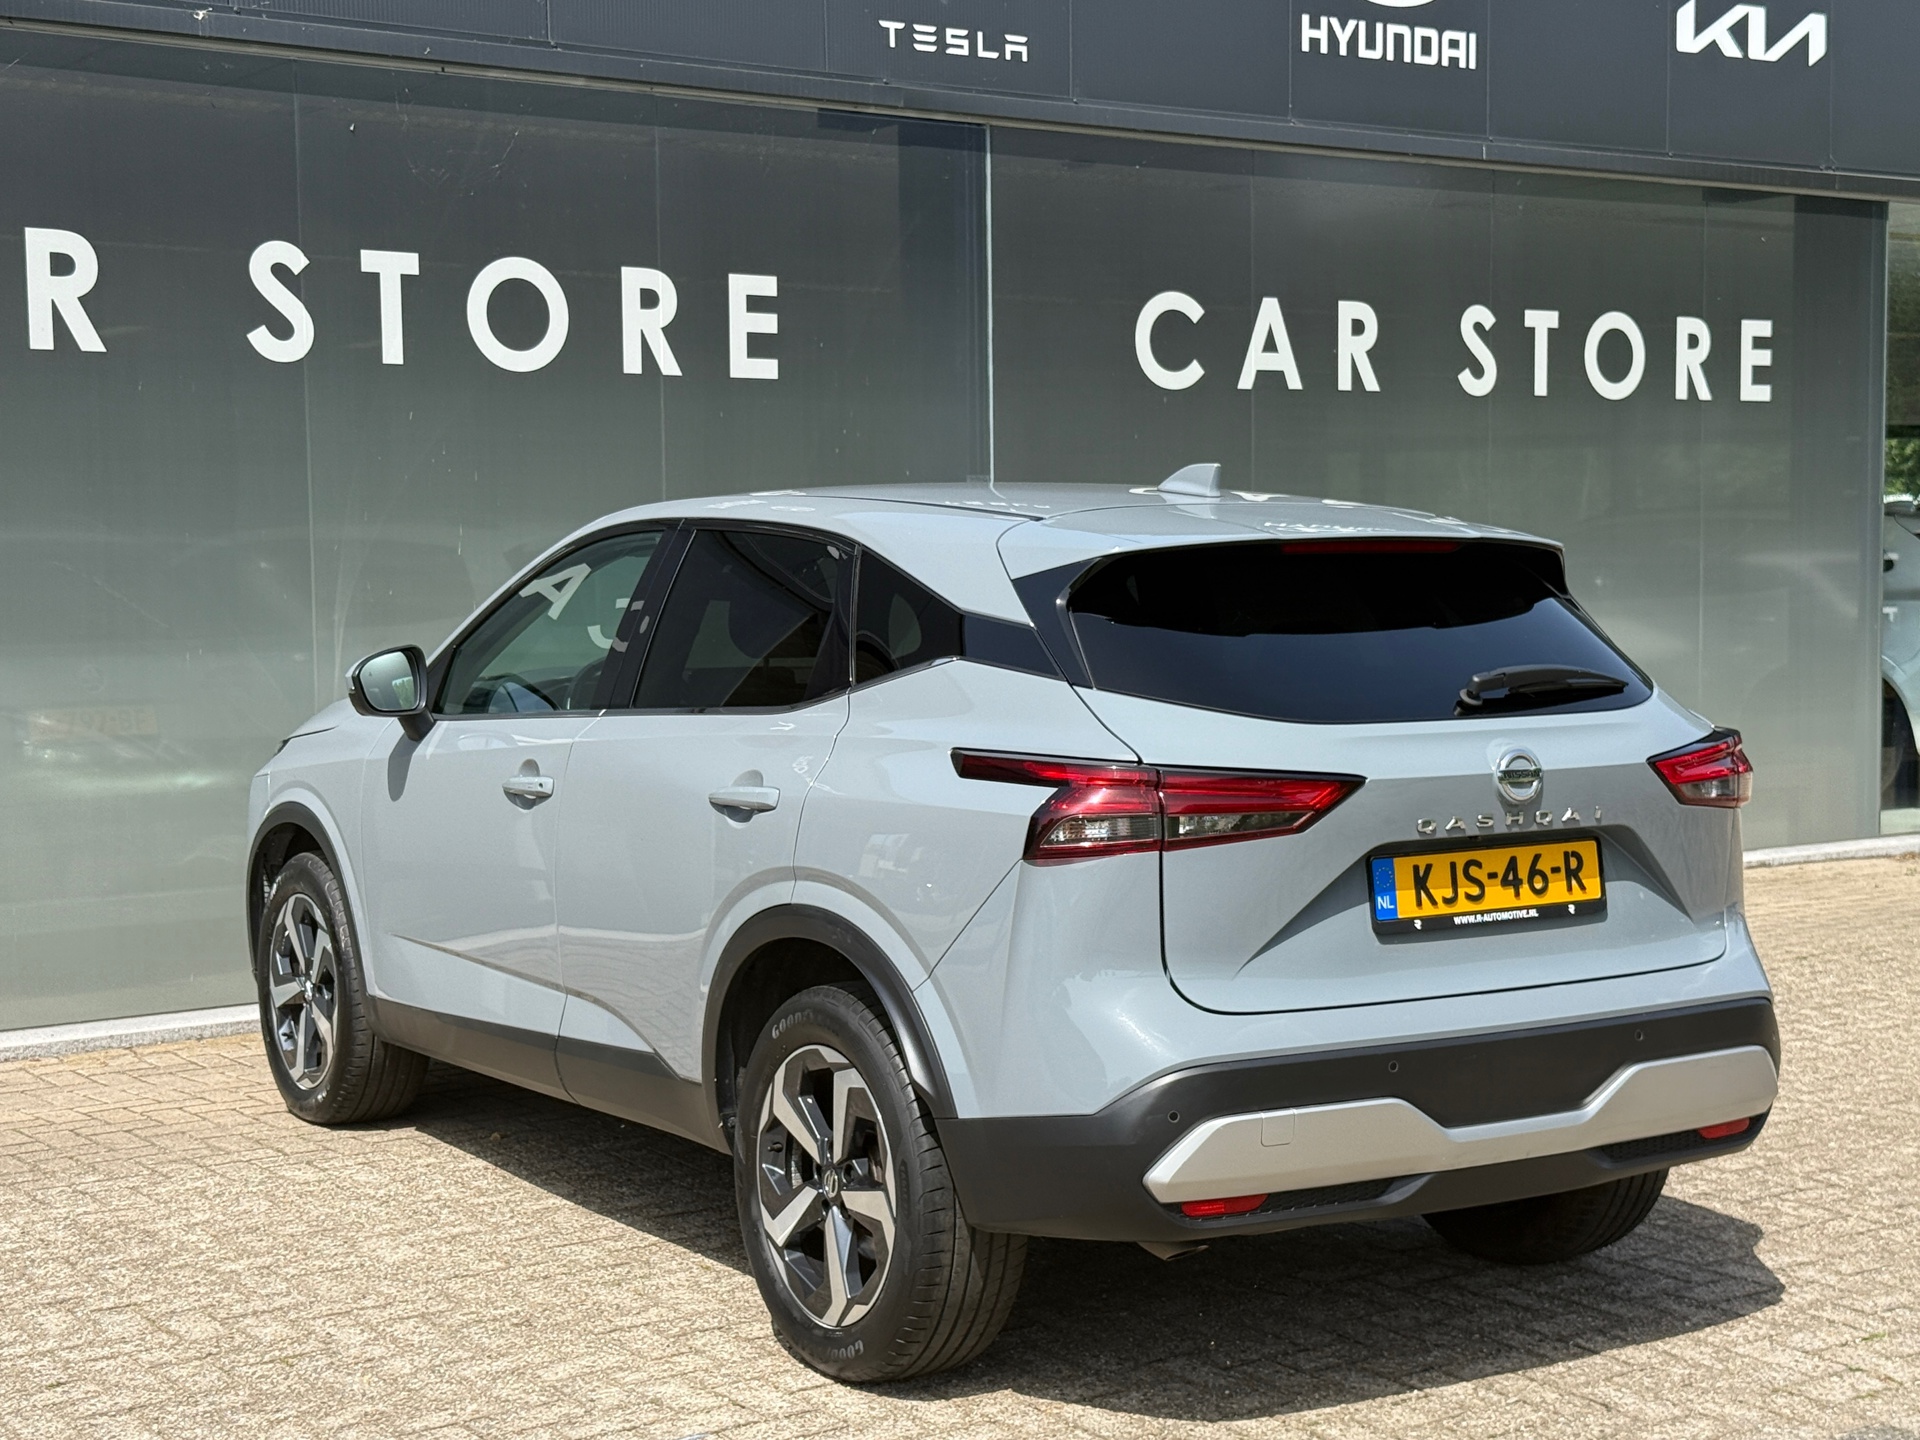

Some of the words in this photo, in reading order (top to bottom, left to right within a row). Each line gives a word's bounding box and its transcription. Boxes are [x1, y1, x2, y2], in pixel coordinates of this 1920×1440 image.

[878, 19, 1028, 62] TESLA
[1301, 13, 1477, 70] HYUNDAI
[1676, 0, 1827, 67] KIA
[246, 240, 779, 380] STORE
[1134, 291, 1381, 392] CAR
[1457, 304, 1772, 402] STORE
[1417, 805, 1602, 834] QASHQAI
[1377, 895, 1395, 910] NL
[1412, 850, 1587, 908] KJS-46-R
